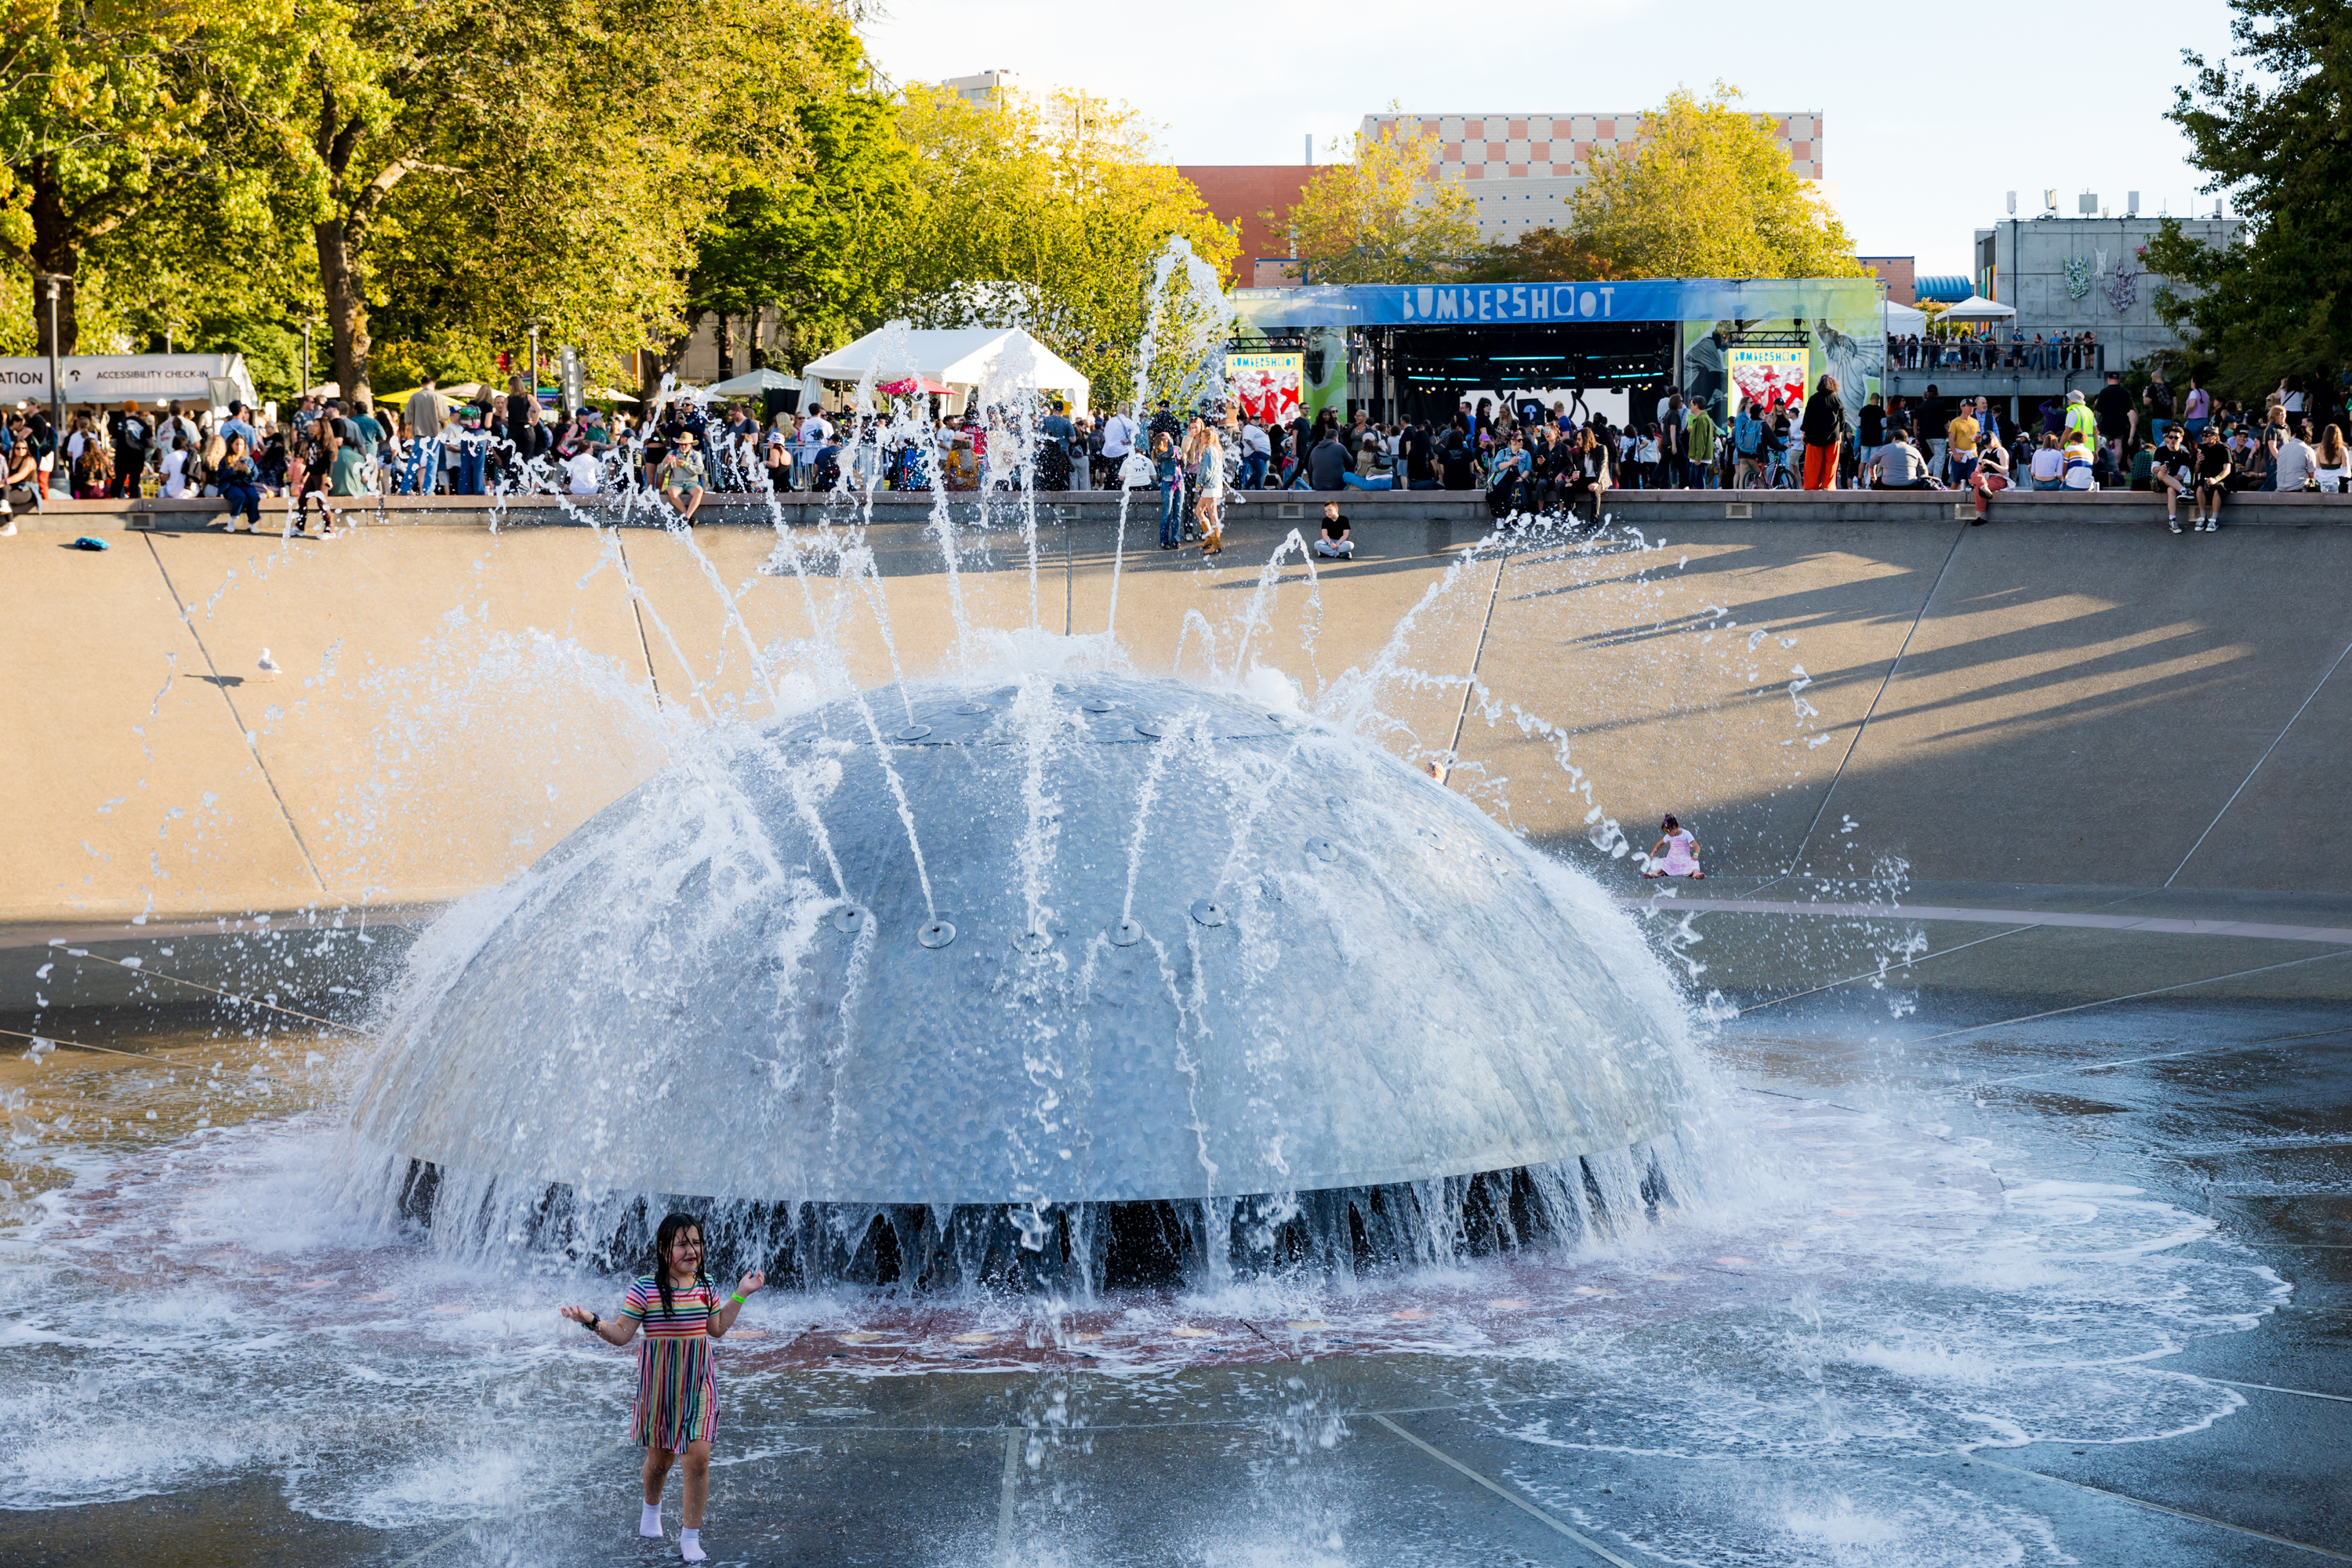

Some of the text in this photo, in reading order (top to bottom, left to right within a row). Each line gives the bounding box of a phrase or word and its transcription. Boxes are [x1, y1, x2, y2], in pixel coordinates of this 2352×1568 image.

[1403, 286, 1615, 320] BUMBERSHOOT
[1232, 357, 1296, 368] BUMBERSHOOT
[1735, 352, 1802, 362] BUMBERSHOOT
[0, 372, 43, 384] ATION
[96, 370, 209, 379] ACCESSIBILITY CHECK-IN
